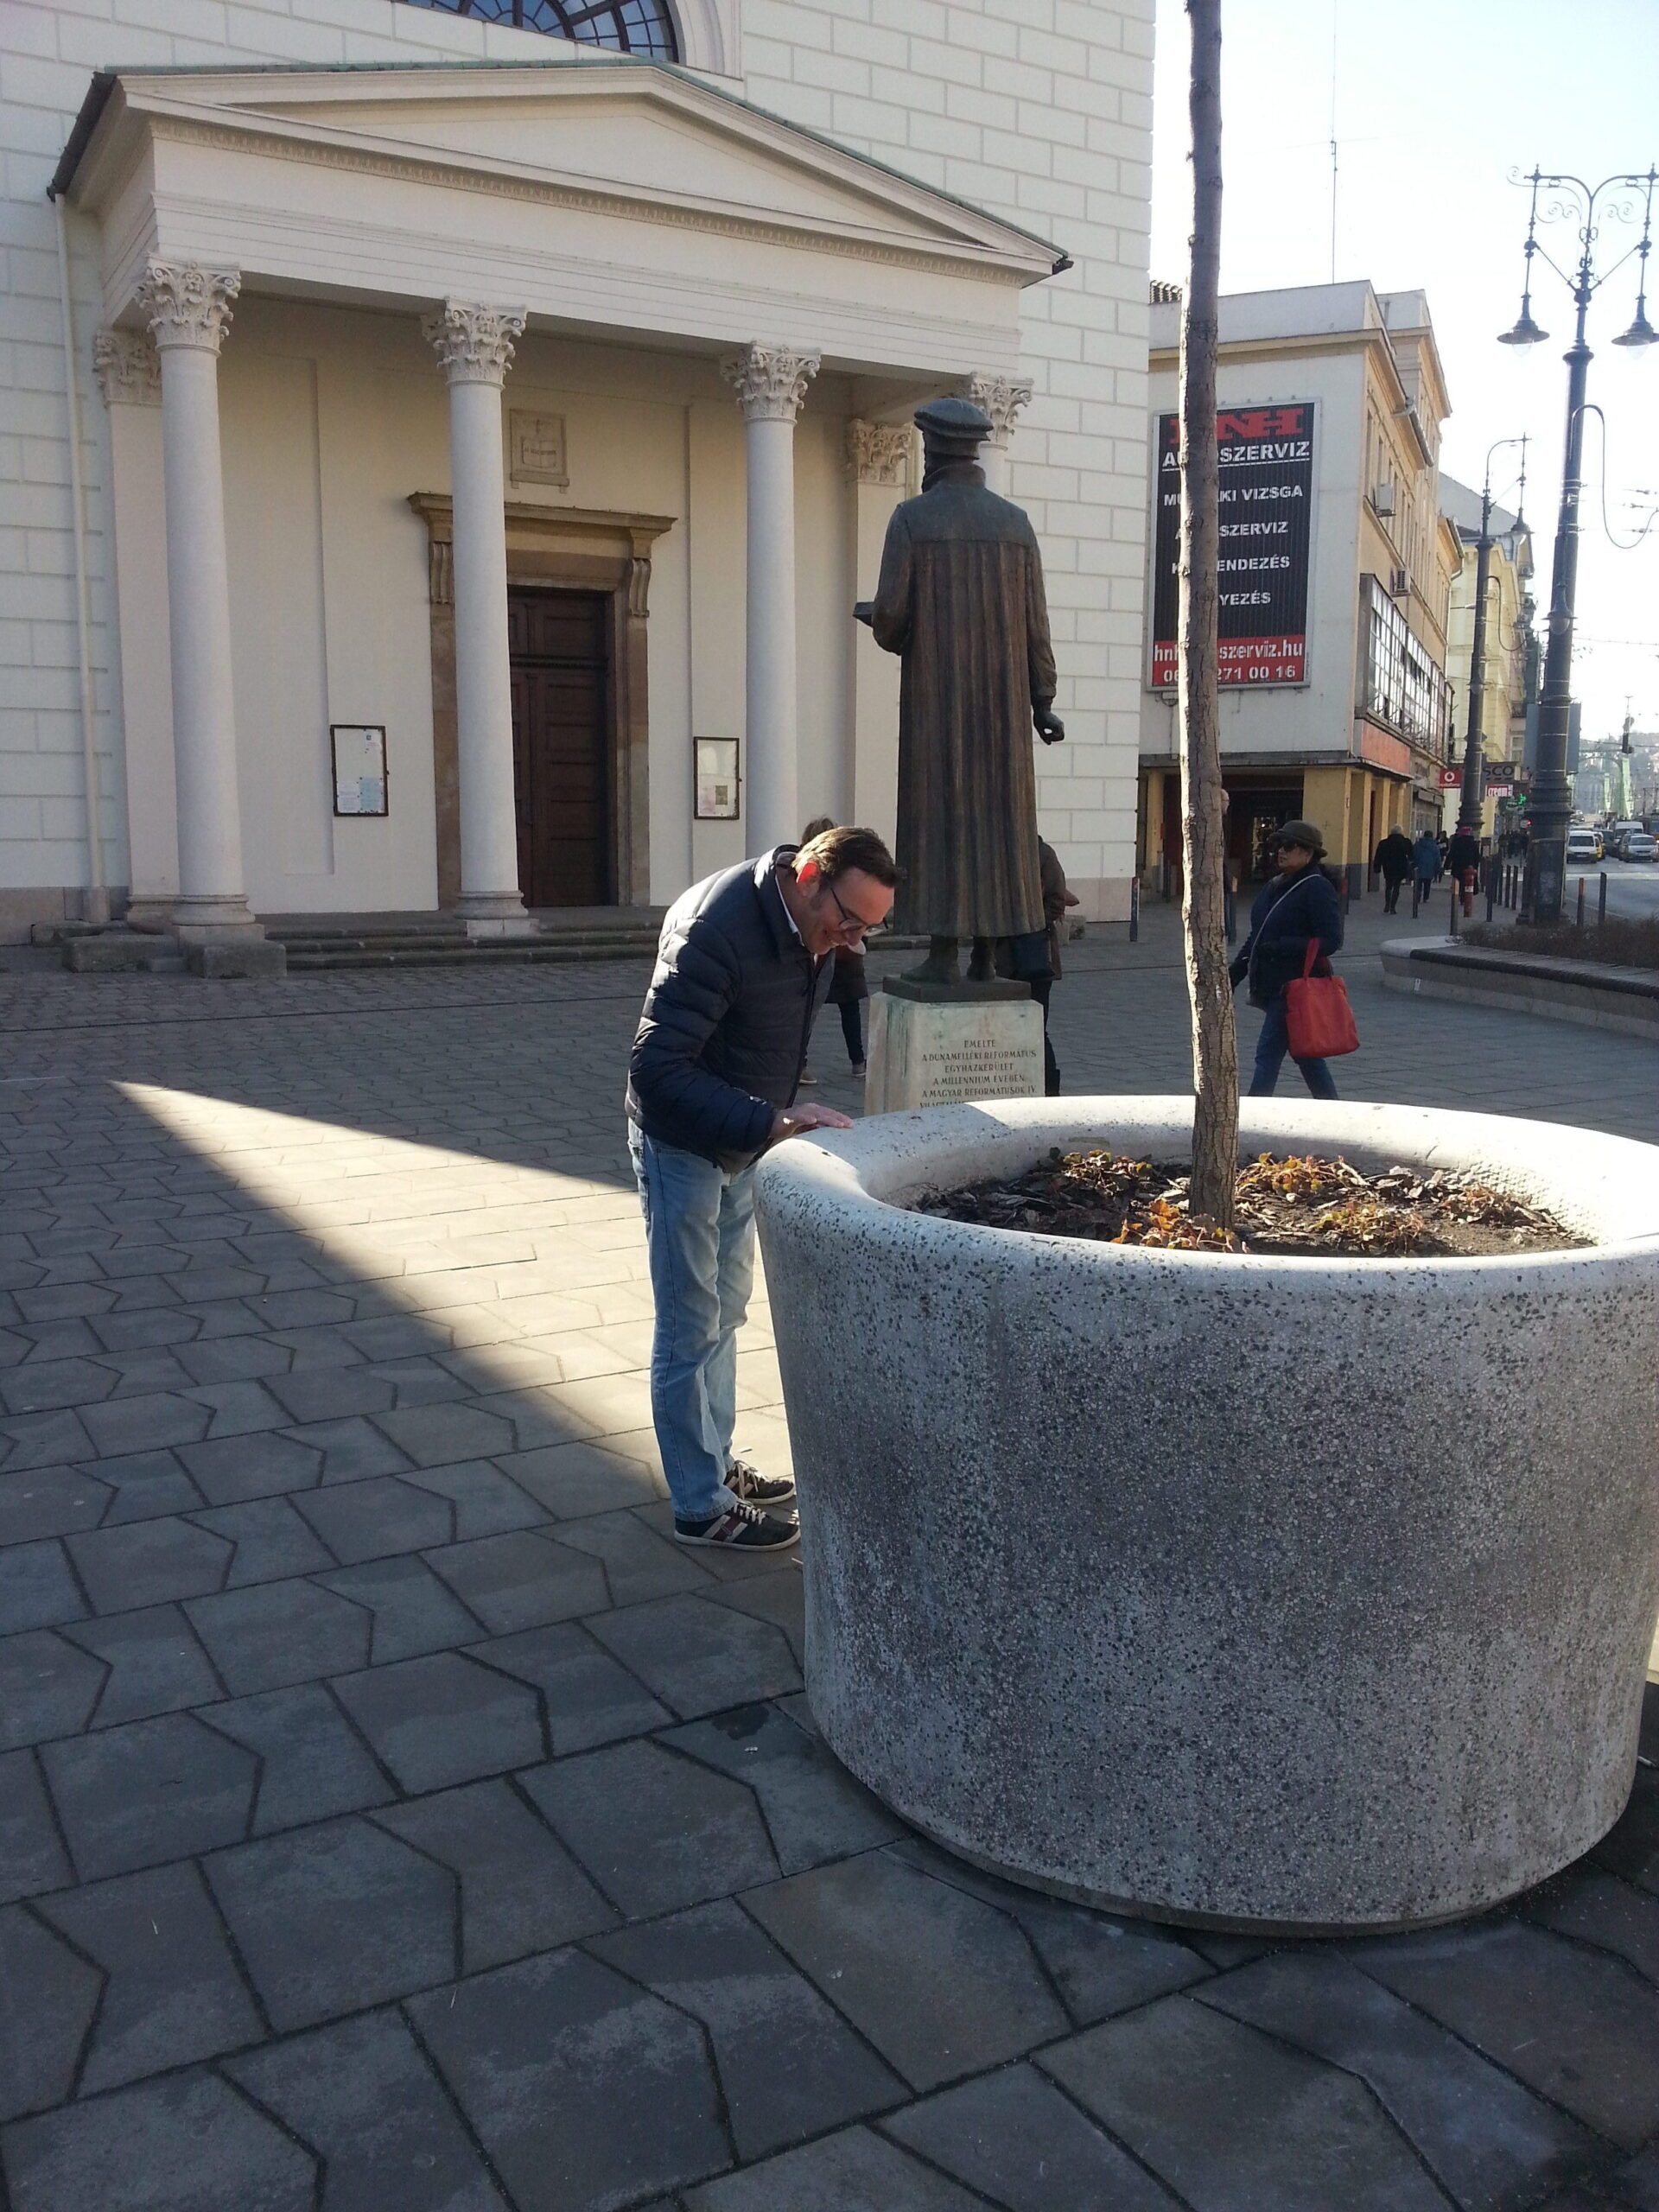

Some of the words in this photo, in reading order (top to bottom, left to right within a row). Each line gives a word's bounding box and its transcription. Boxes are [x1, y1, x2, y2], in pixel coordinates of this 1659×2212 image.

[1170, 407, 1304, 444] NH
[1162, 441, 1310, 467] ASZERVIZ
[1242, 485, 1303, 501] VIZSGA
[1249, 666, 1269, 679] 00
[1275, 664, 1295, 678] 16
[964, 1039, 995, 1048] EMELTE
[984, 1047, 1037, 1059] REFORMÁTUS
[941, 1075, 990, 1084] MILLENNIUM
[929, 1088, 962, 1097] MAGYAR
